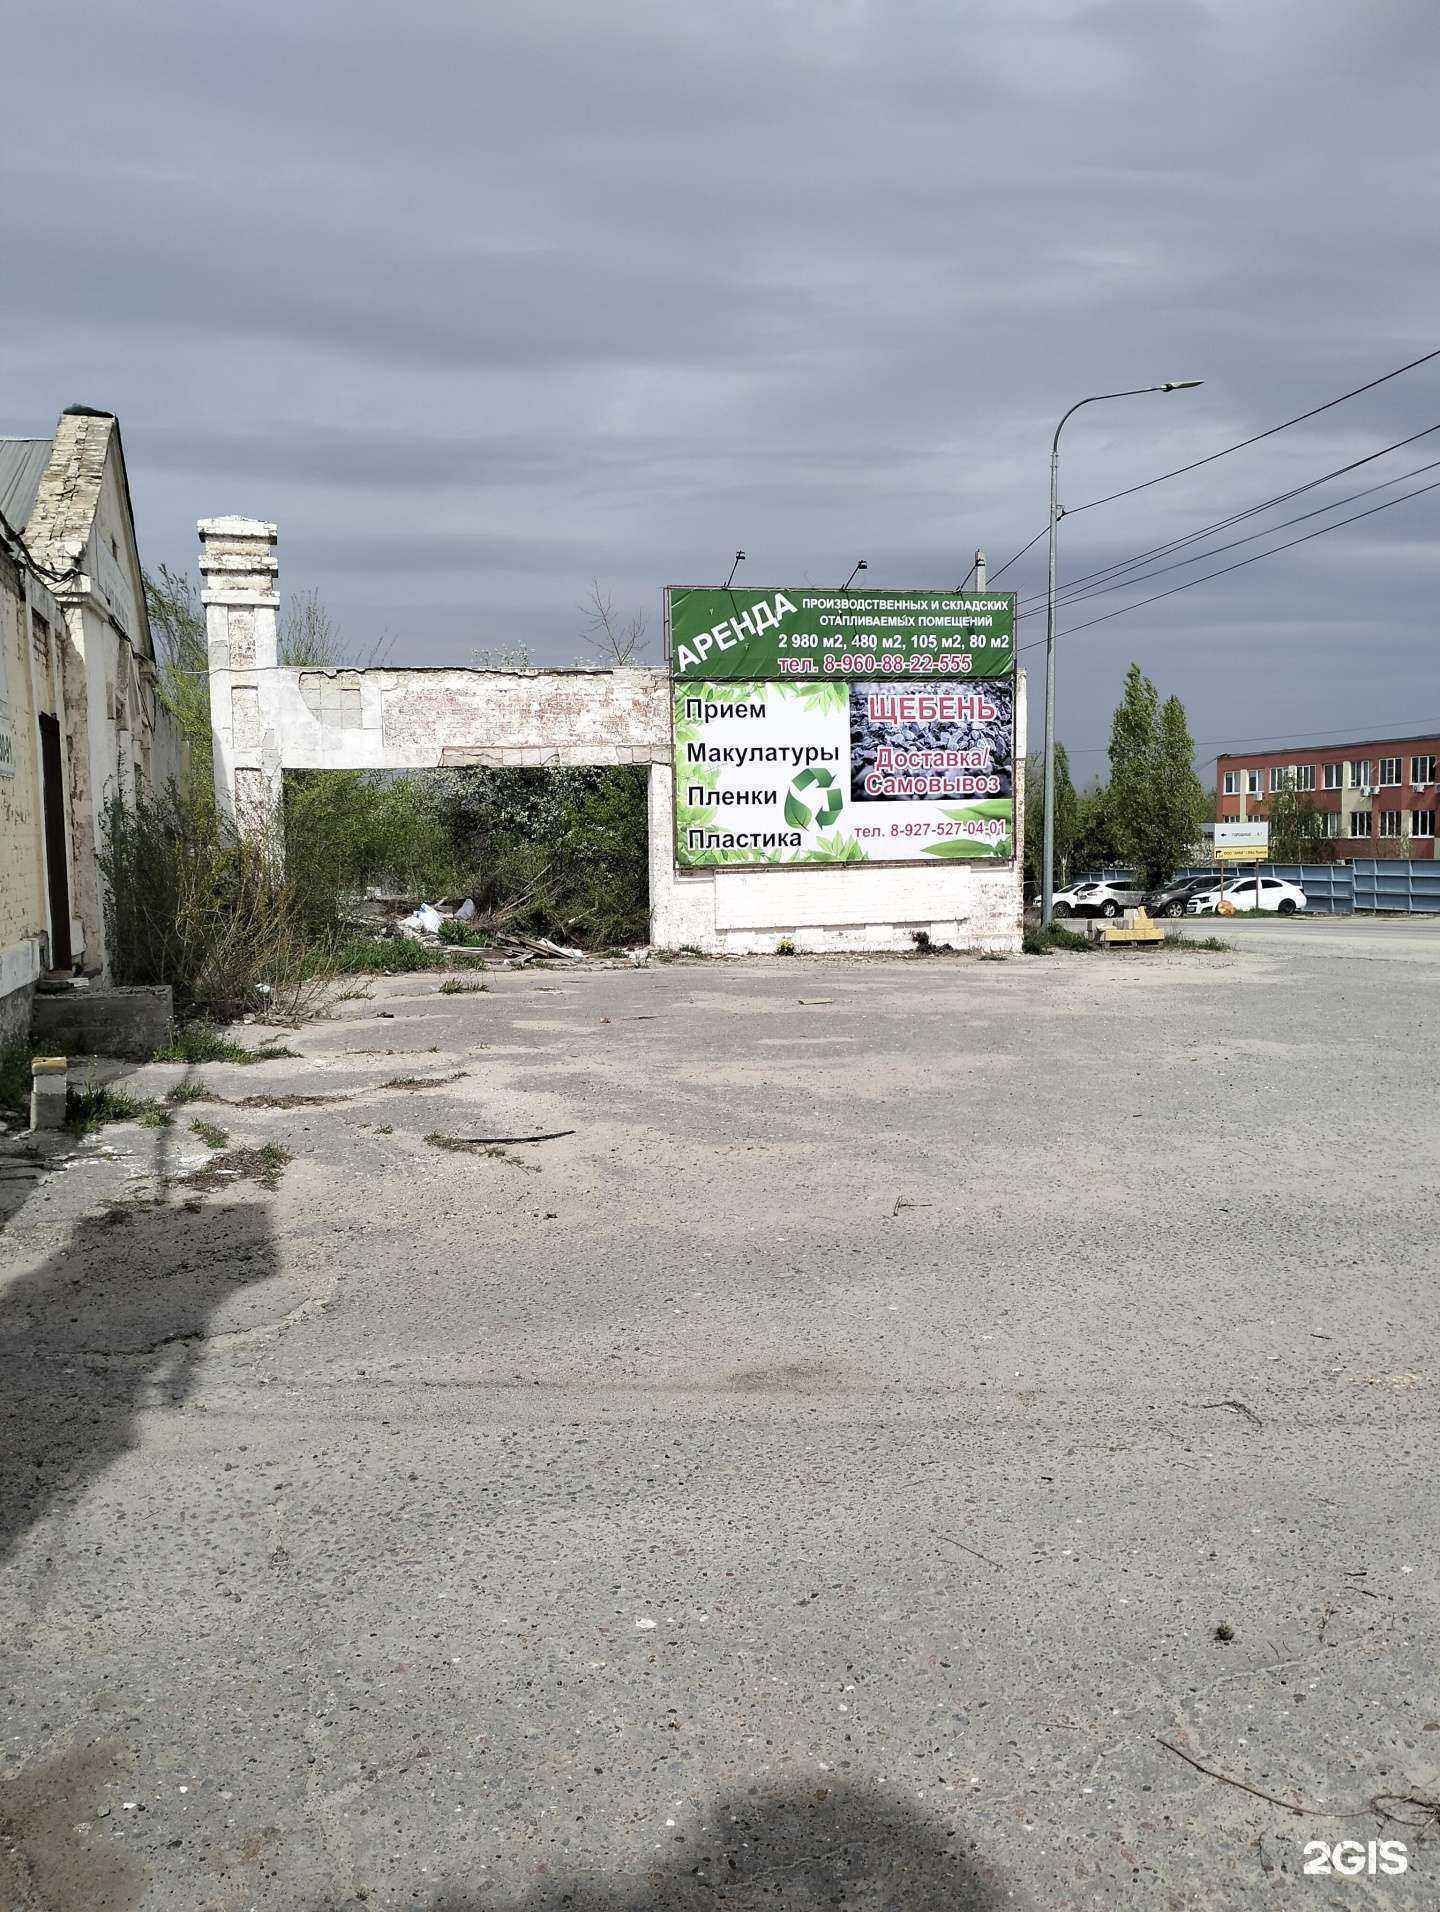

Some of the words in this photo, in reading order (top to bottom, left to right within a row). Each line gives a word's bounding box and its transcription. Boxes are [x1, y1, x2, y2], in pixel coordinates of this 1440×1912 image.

[802, 598, 928, 611] ПРОИЗВОДСТВЕННЫХ
[931, 600, 940, 610] И
[941, 600, 1009, 612] СКЛАДСКИХ
[819, 614, 916, 627] ОТАПЛИВАЕМЫХ
[918, 615, 993, 627] ПОМЕЩЕНИЙ
[677, 592, 798, 672] АРЕНДА
[778, 634, 788, 648] 2
[791, 634, 819, 648] 980
[822, 634, 847, 650] м2,
[882, 635, 906, 650] м2,
[942, 635, 965, 650] м2,
[969, 634, 987, 649] 80
[990, 635, 1010, 649] м2
[778, 657, 819, 673] тел.
[823, 653, 972, 673] 8-960-88-22-555
[686, 698, 766, 723] Прием
[868, 695, 997, 725] ЩЕБЕНЬ
[687, 742, 839, 767] Макулатуры
[874, 747, 991, 772] Доставка/
[865, 773, 1001, 795] Самовывоз
[688, 786, 777, 806] Пленки
[854, 826, 885, 837] тел.
[890, 819, 1005, 837] 8-927-527-04-01
[688, 829, 802, 849] Пластика
